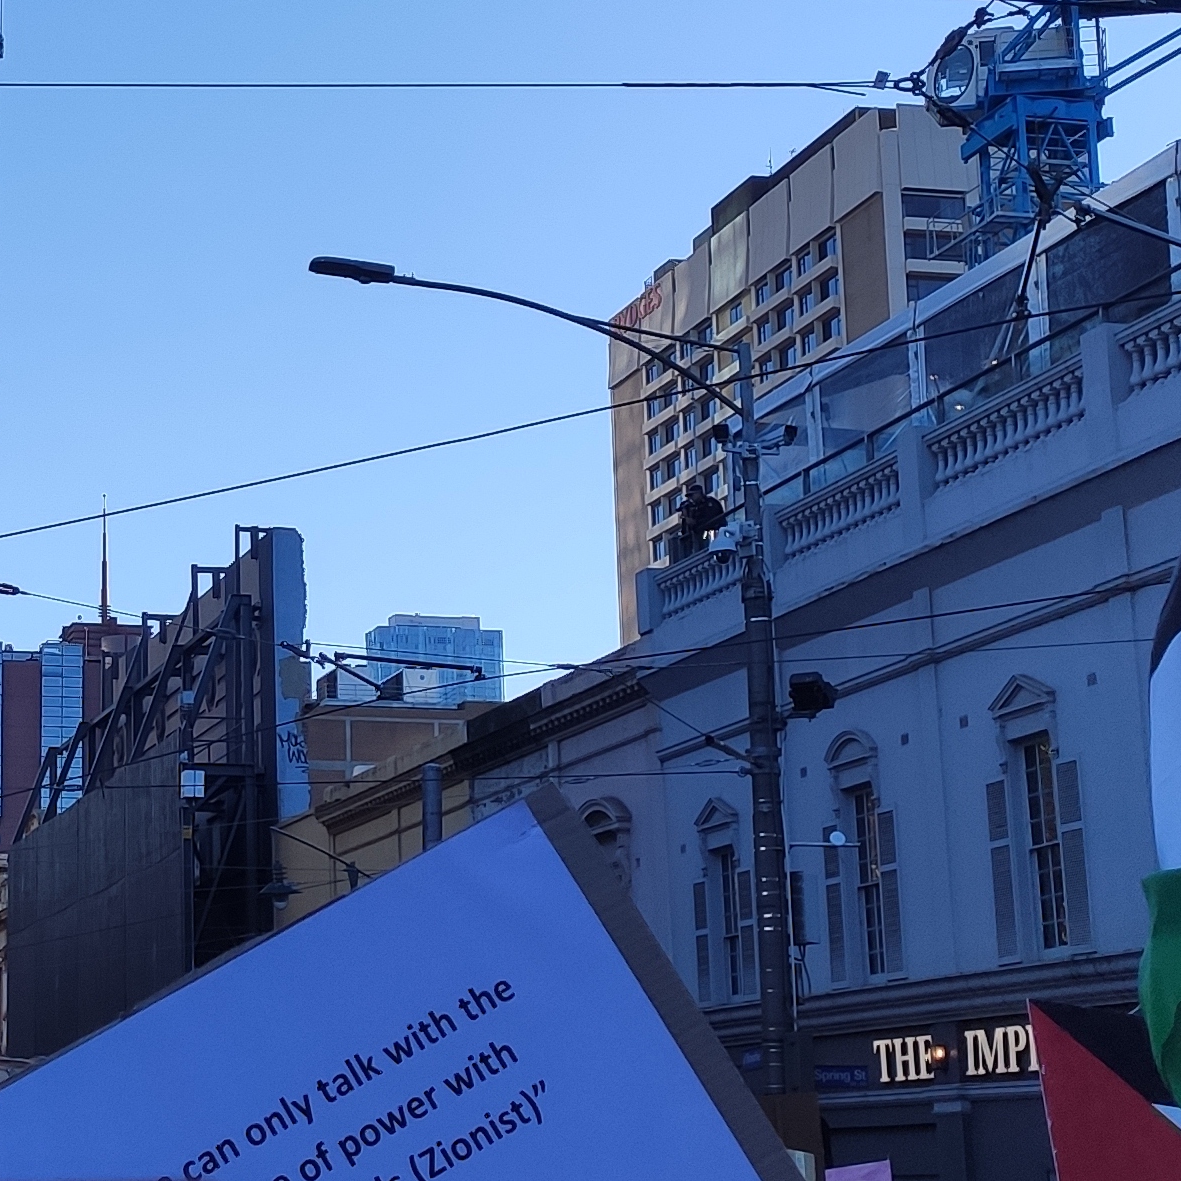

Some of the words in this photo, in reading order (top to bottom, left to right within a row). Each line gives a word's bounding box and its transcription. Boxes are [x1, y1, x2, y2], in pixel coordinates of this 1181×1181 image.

[182, 1136, 241, 1181] can
[245, 1093, 314, 1146] only
[316, 1053, 383, 1103] talk
[382, 1010, 458, 1066] with
[458, 980, 516, 1021] the
[815, 1069, 851, 1083] Spring
[854, 1069, 867, 1081] St
[873, 1034, 935, 1083] THE
[298, 1140, 333, 1181] of
[337, 1086, 439, 1167] power
[441, 1041, 519, 1097] with
